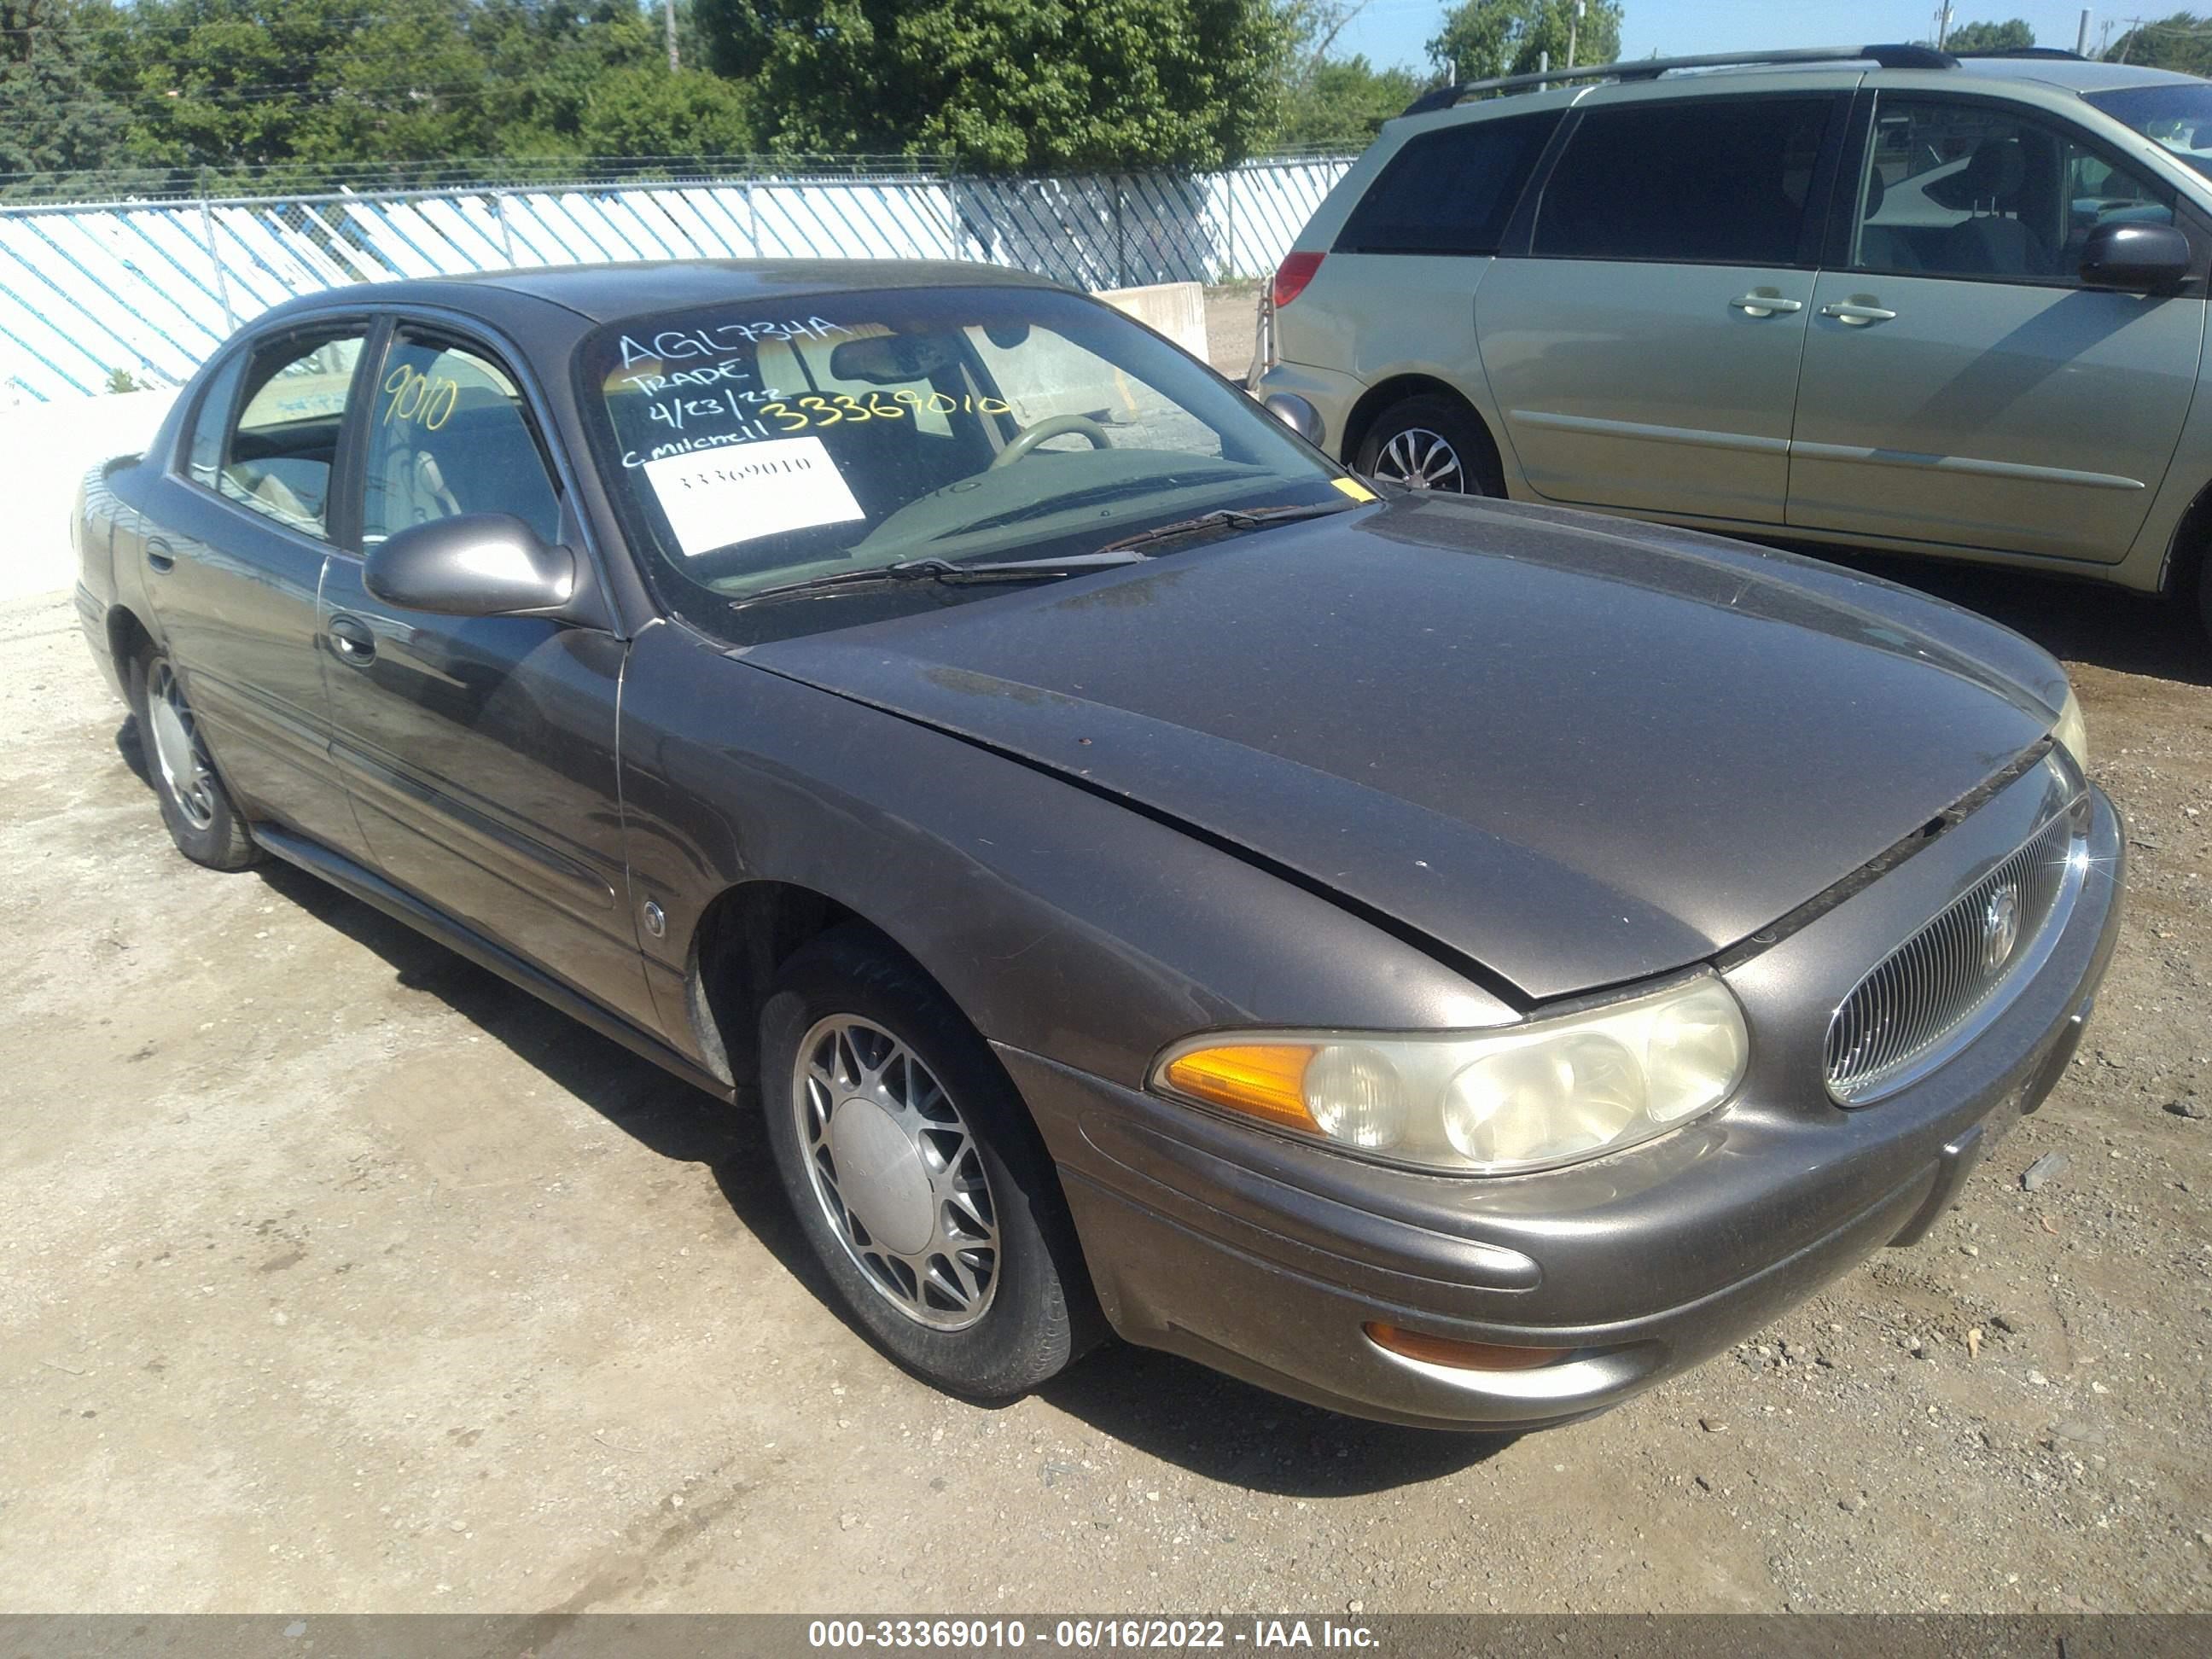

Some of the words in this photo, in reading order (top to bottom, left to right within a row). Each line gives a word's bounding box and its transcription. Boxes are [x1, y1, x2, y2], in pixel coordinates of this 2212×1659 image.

[383, 364, 457, 430] 9010
[621, 358, 749, 397] TRADE
[759, 390, 1011, 431] 33369010
[680, 457, 812, 489] 33369010
